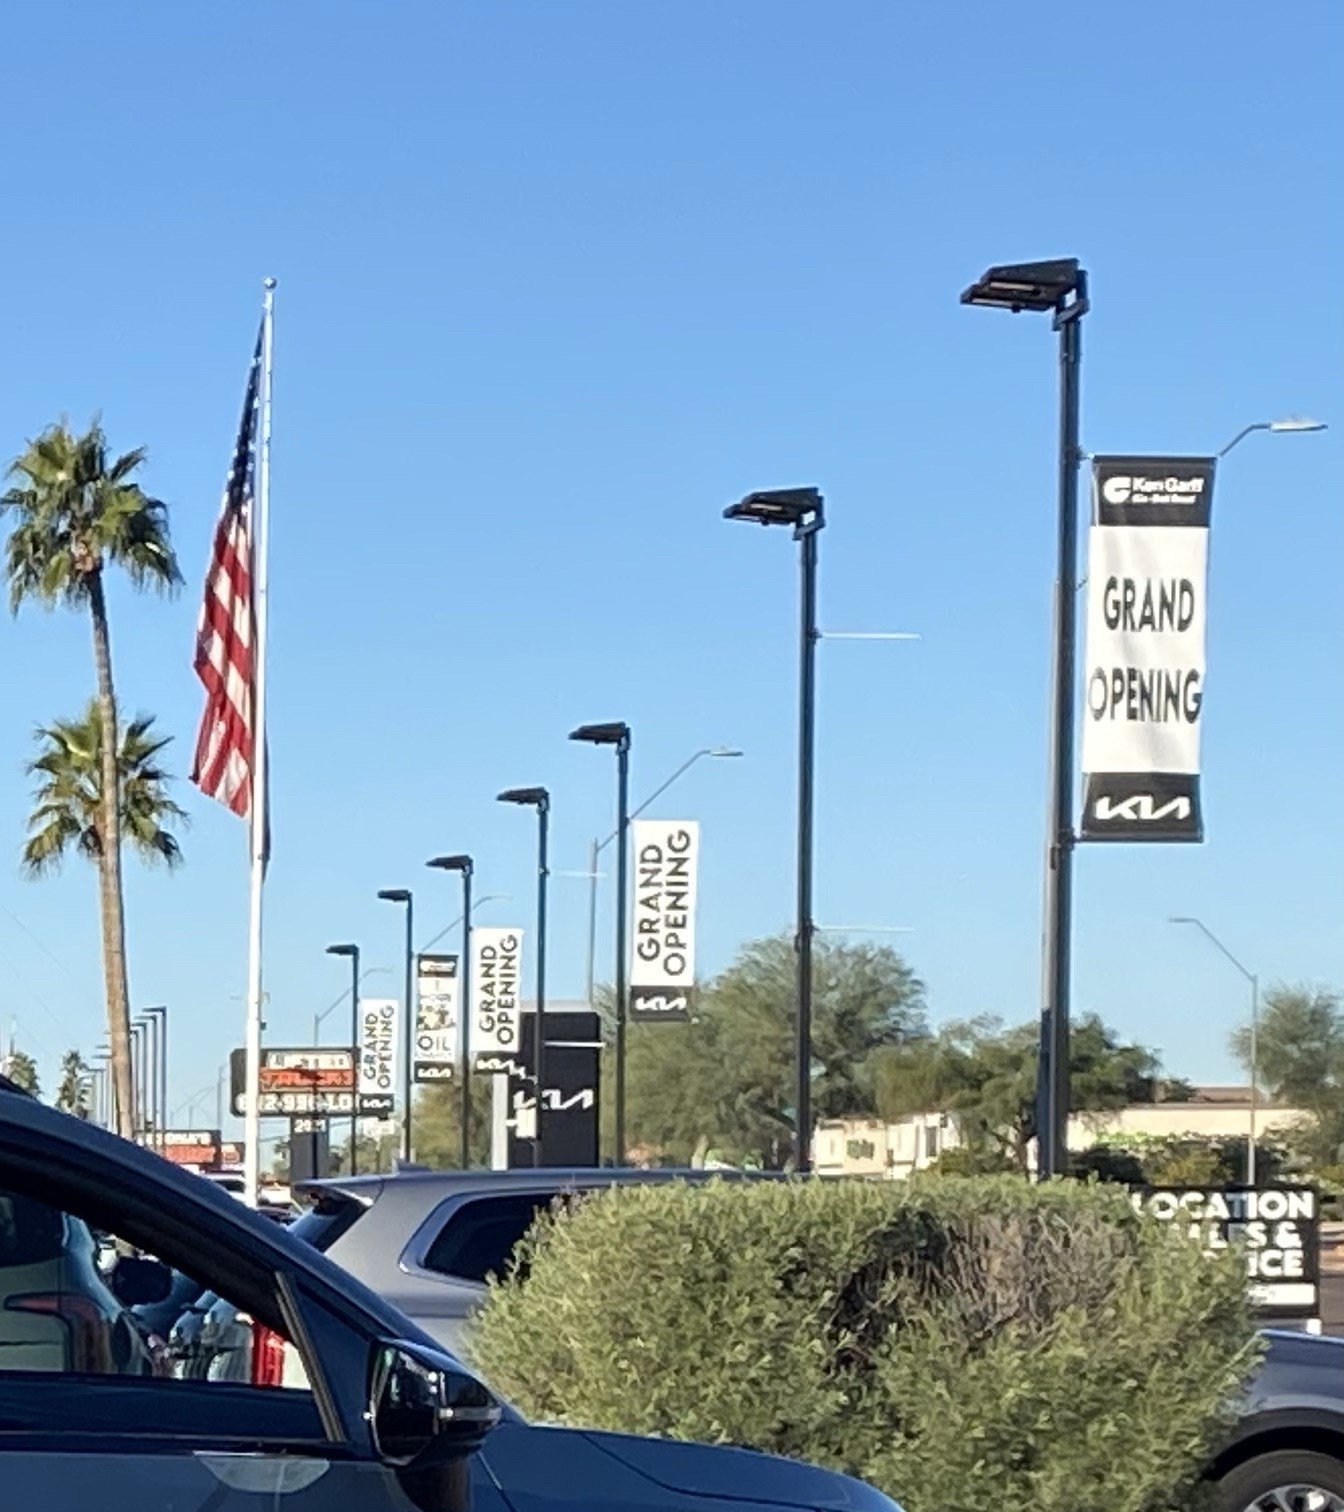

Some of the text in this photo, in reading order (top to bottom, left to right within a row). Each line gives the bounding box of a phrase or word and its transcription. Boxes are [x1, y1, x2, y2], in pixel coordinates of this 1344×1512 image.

[1103, 575, 1195, 632] GRAND
[1088, 667, 1204, 724] OPENING
[637, 844, 664, 962] GRAND
[663, 829, 692, 977] OPENING
[479, 945, 497, 1033] GRAND
[496, 934, 518, 1045] OPENING
[363, 1013, 379, 1080] GRAND
[377, 1005, 395, 1089] OPENING
[1275, 1221, 1303, 1249] &
